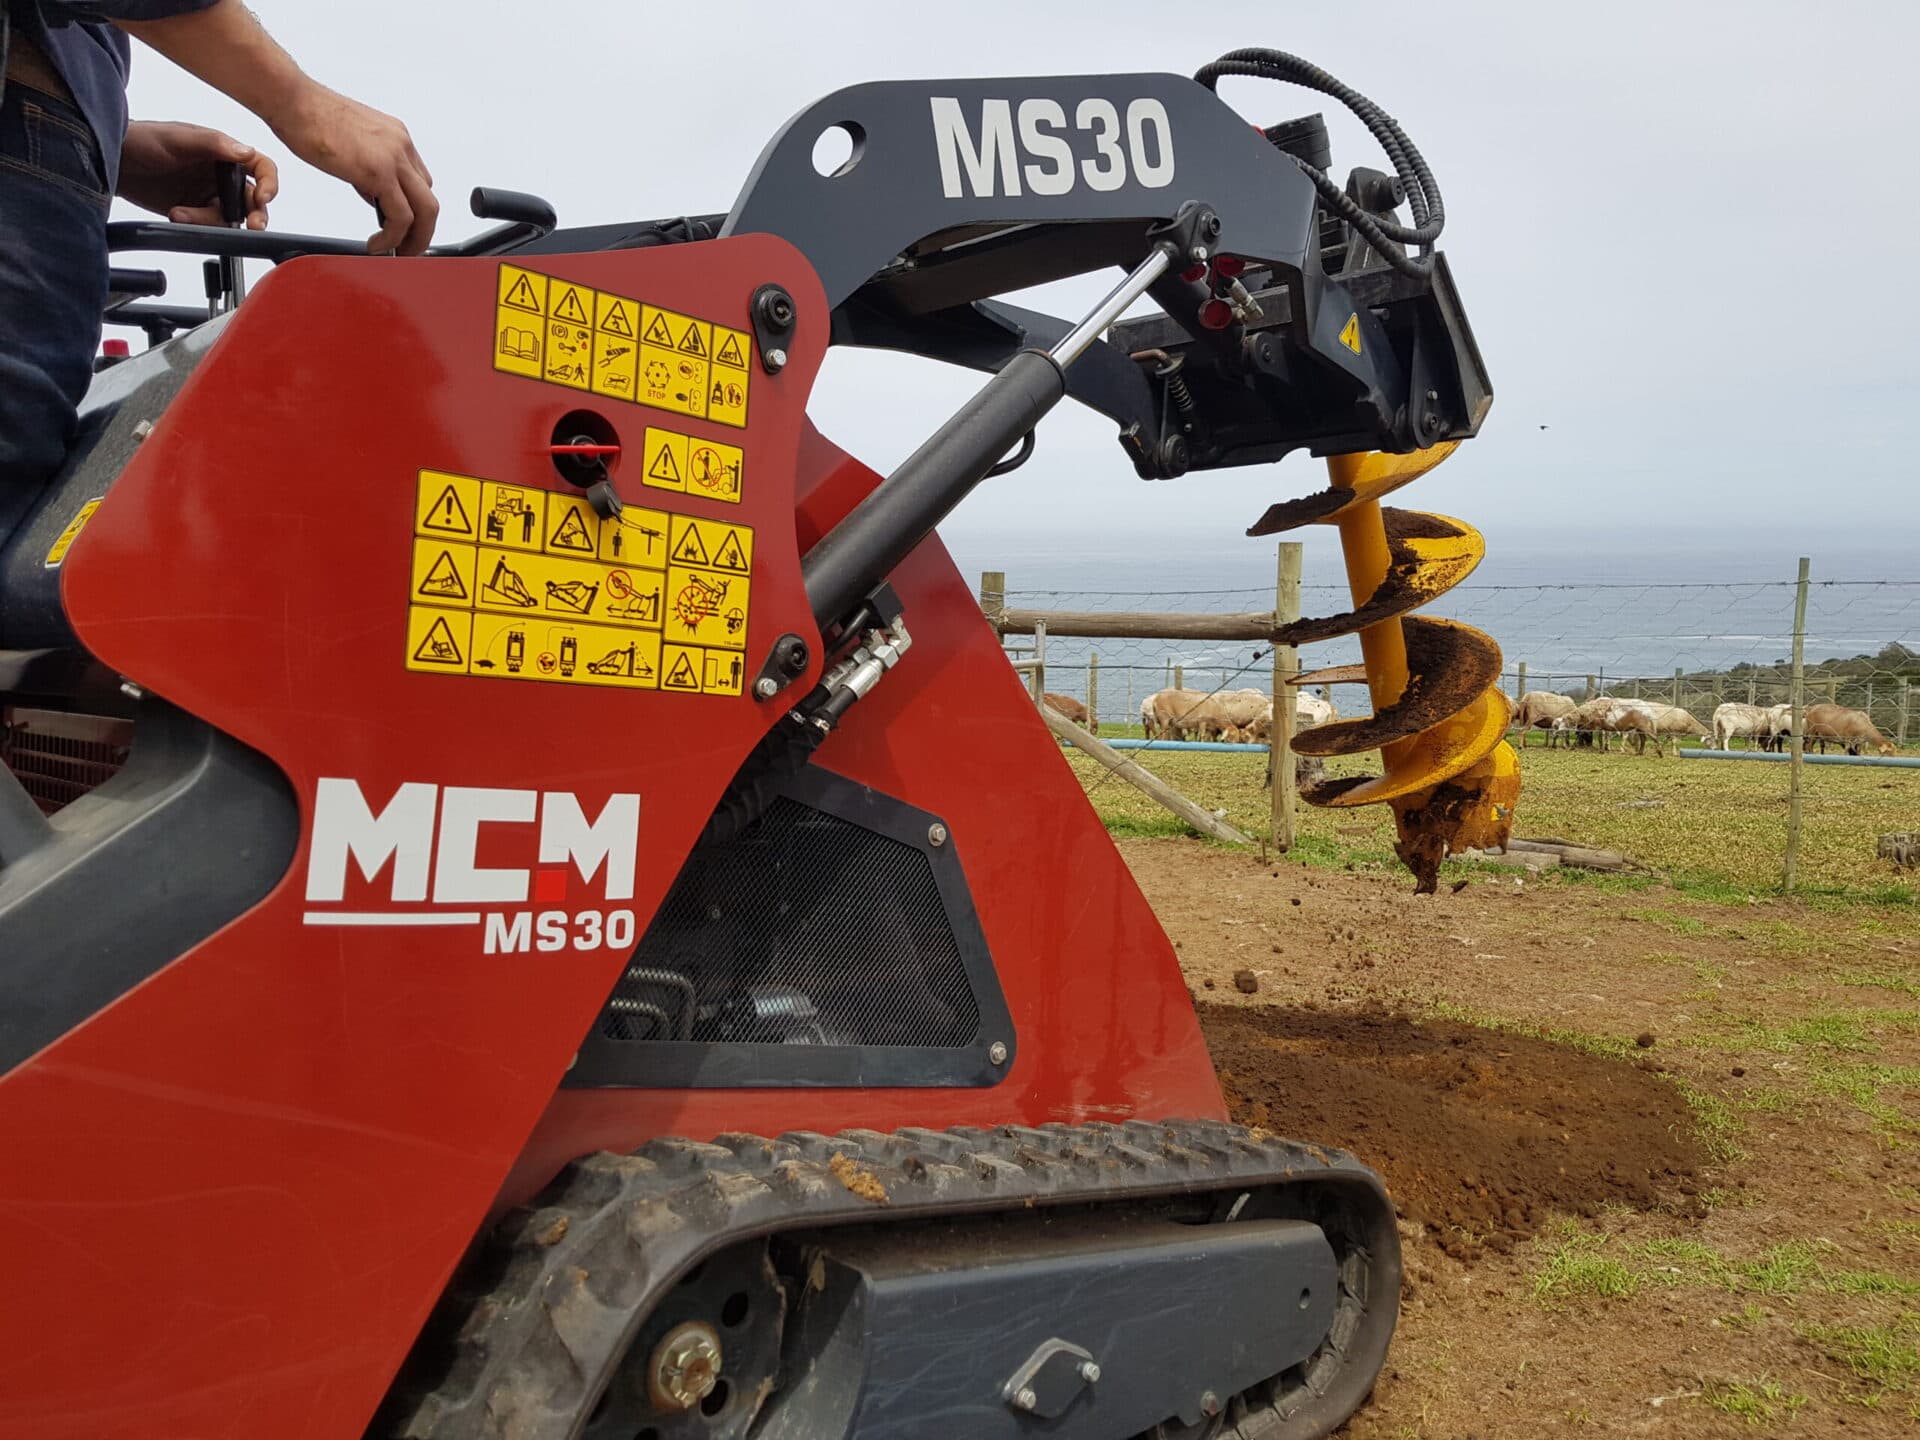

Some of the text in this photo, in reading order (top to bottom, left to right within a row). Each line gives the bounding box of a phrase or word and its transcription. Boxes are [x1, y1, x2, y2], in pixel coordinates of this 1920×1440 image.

[930, 97, 1175, 198] MS30
[647, 388, 666, 400] STOP
[305, 777, 641, 903] MCM
[483, 909, 636, 954] MS30
